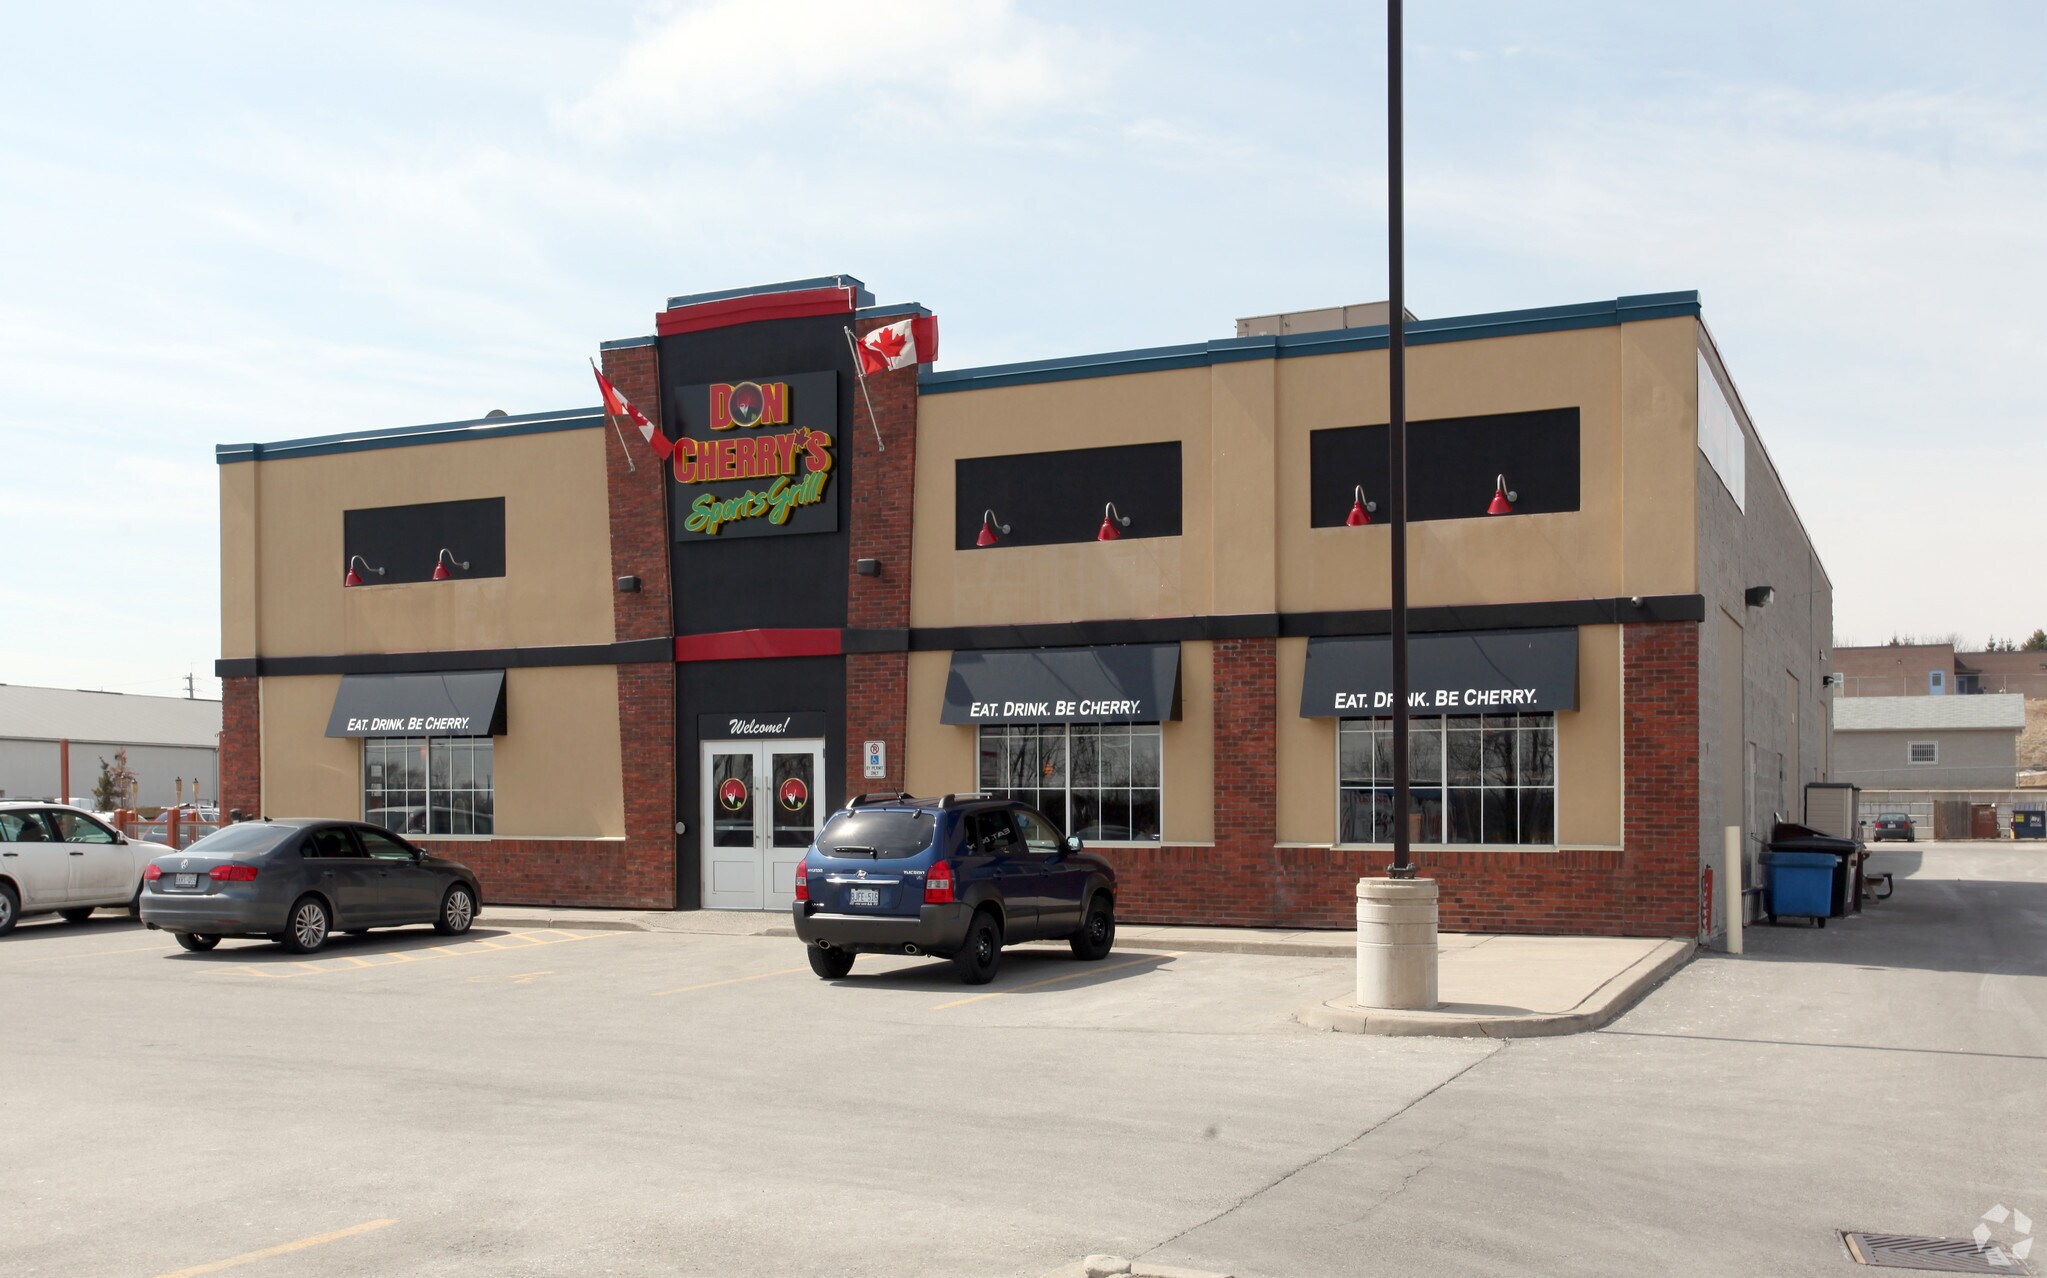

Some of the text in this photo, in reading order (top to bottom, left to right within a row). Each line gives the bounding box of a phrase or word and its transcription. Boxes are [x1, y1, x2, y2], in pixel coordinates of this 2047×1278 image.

[710, 381, 788, 430] DON
[673, 430, 832, 484] CHERRY'S
[685, 471, 828, 535] Sports Grill
[970, 700, 1141, 717] EAT. DRINK. BE CHERRY.
[1334, 688, 1537, 709] EAT. DRNK. BE CHERRY.
[347, 716, 469, 731] EAT. DRINK. BE CHERRY.
[729, 717, 791, 735] Welcome!
